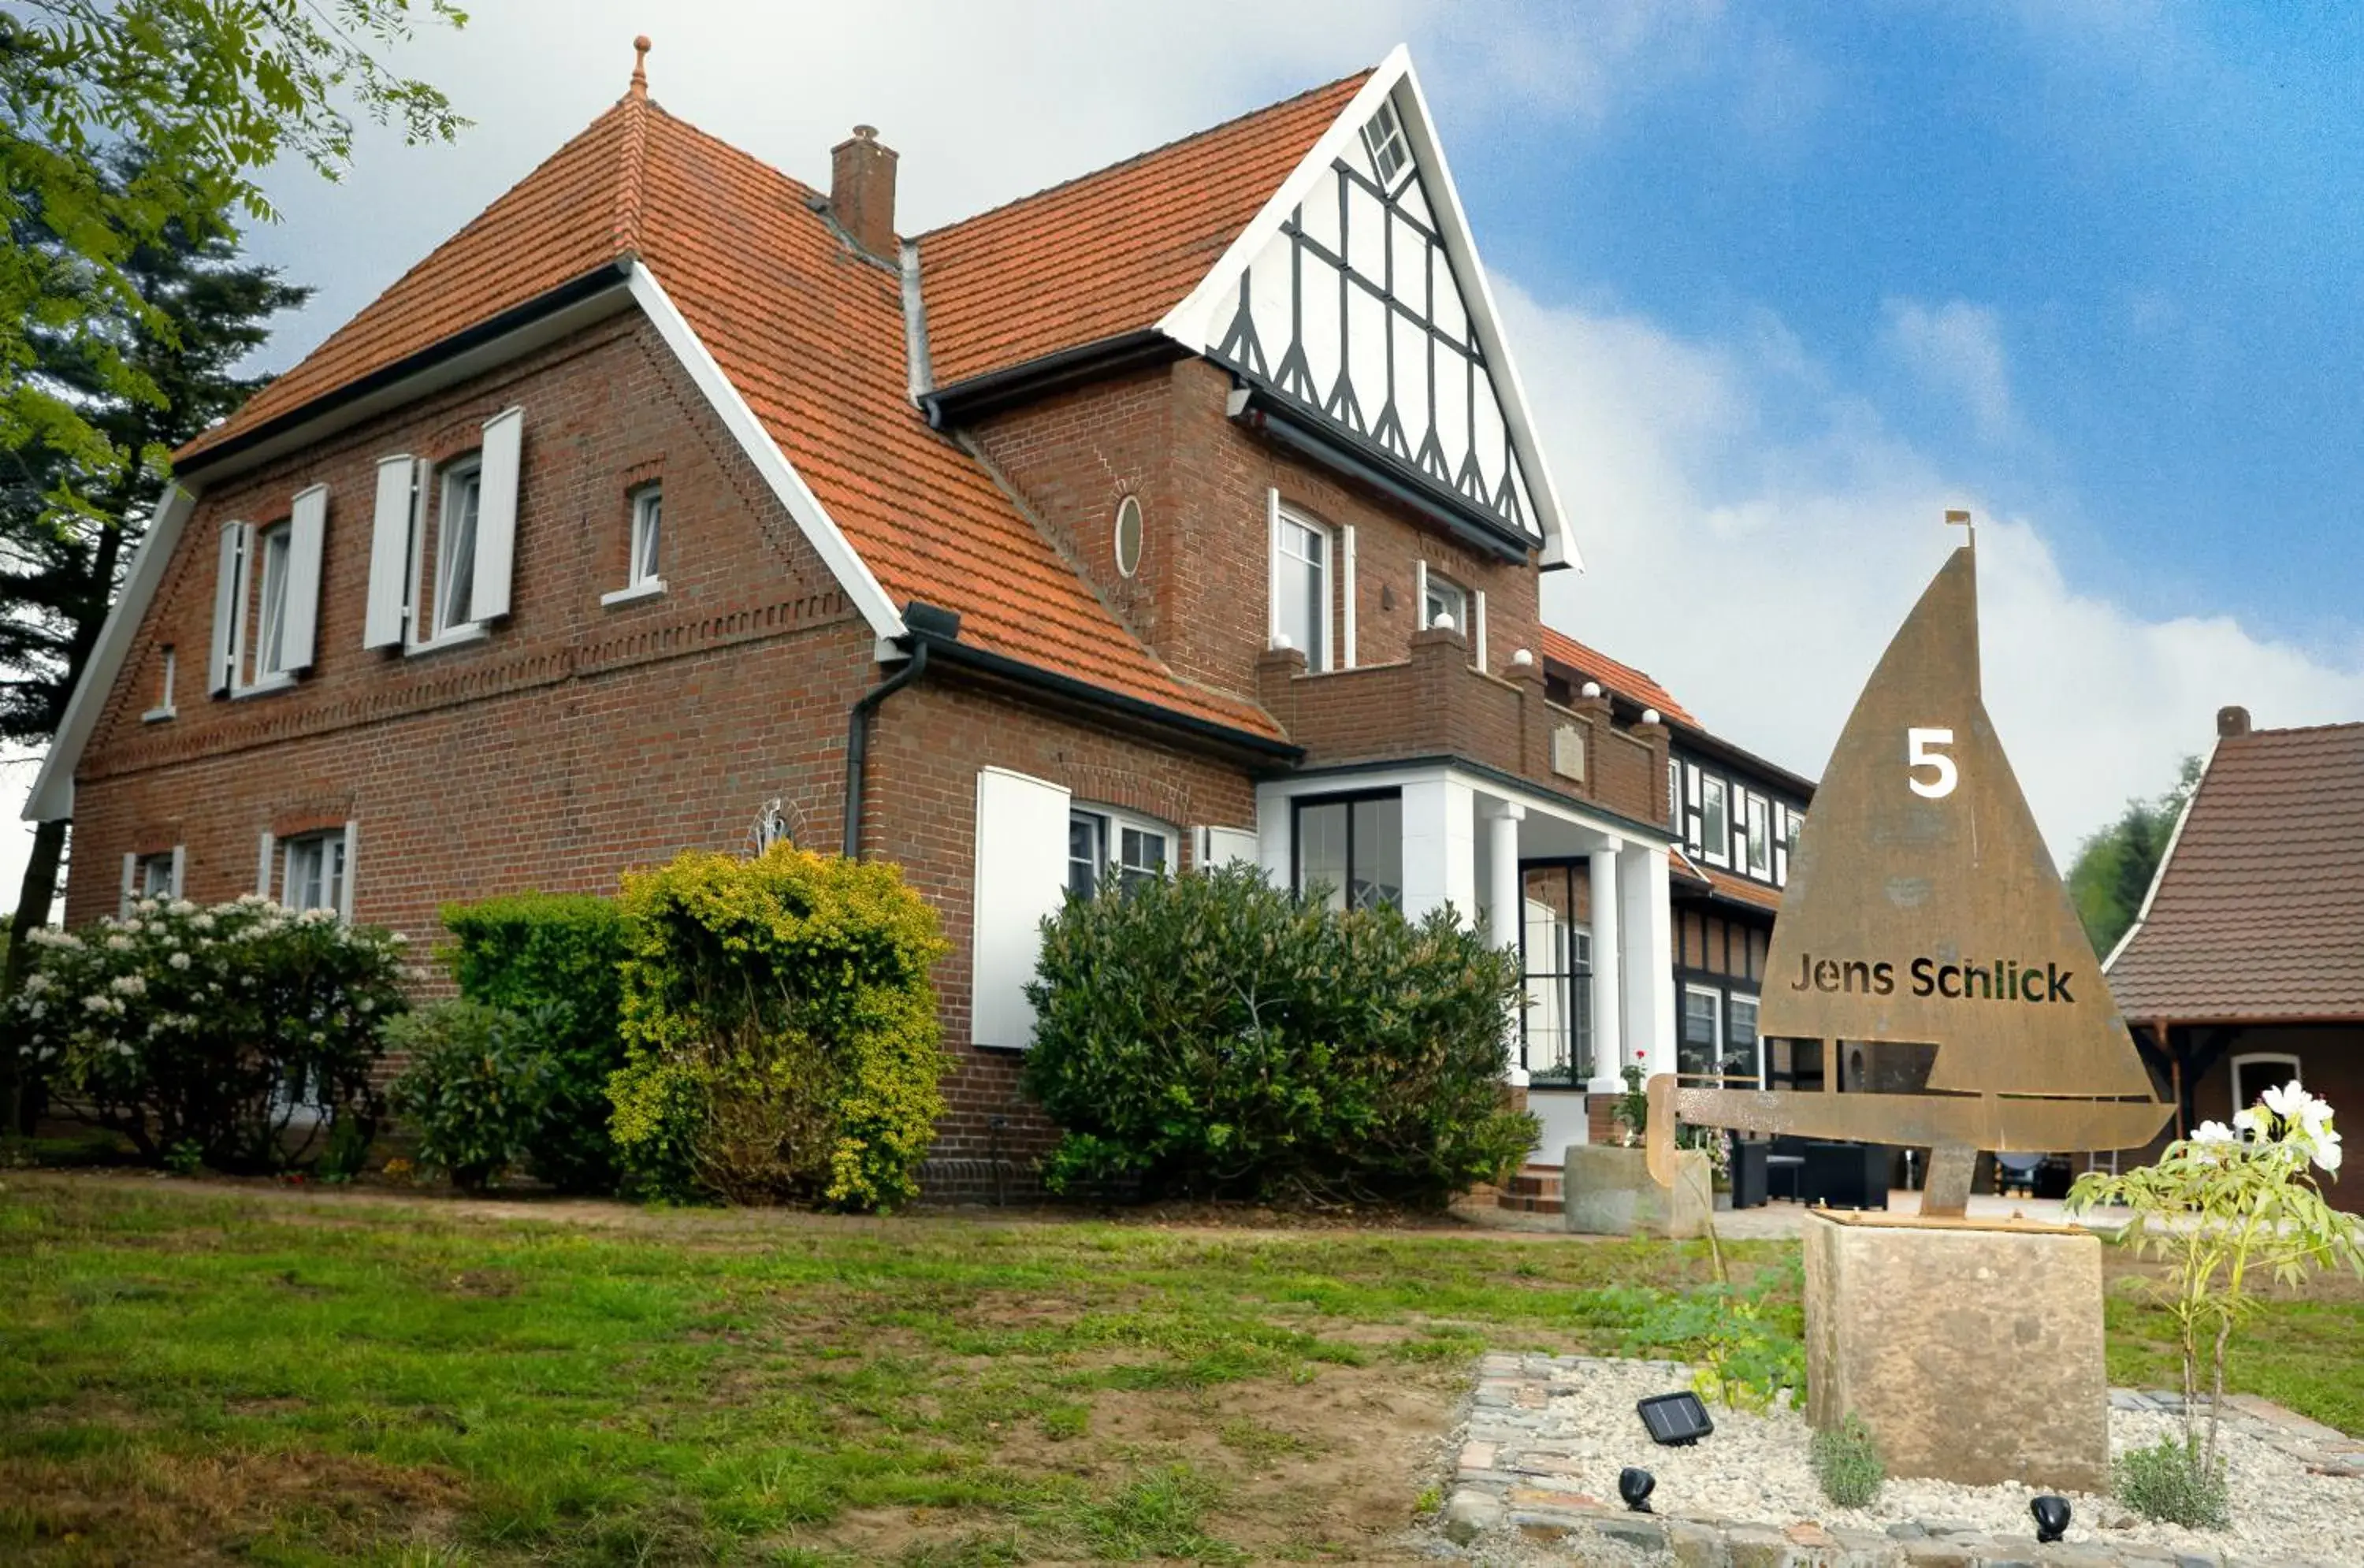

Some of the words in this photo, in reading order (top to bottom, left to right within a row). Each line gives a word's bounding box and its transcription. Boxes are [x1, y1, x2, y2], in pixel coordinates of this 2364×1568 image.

[1908, 727, 1958, 798] 5
[1791, 953, 1894, 996] Jens
[1911, 957, 2076, 1003] Schlick
